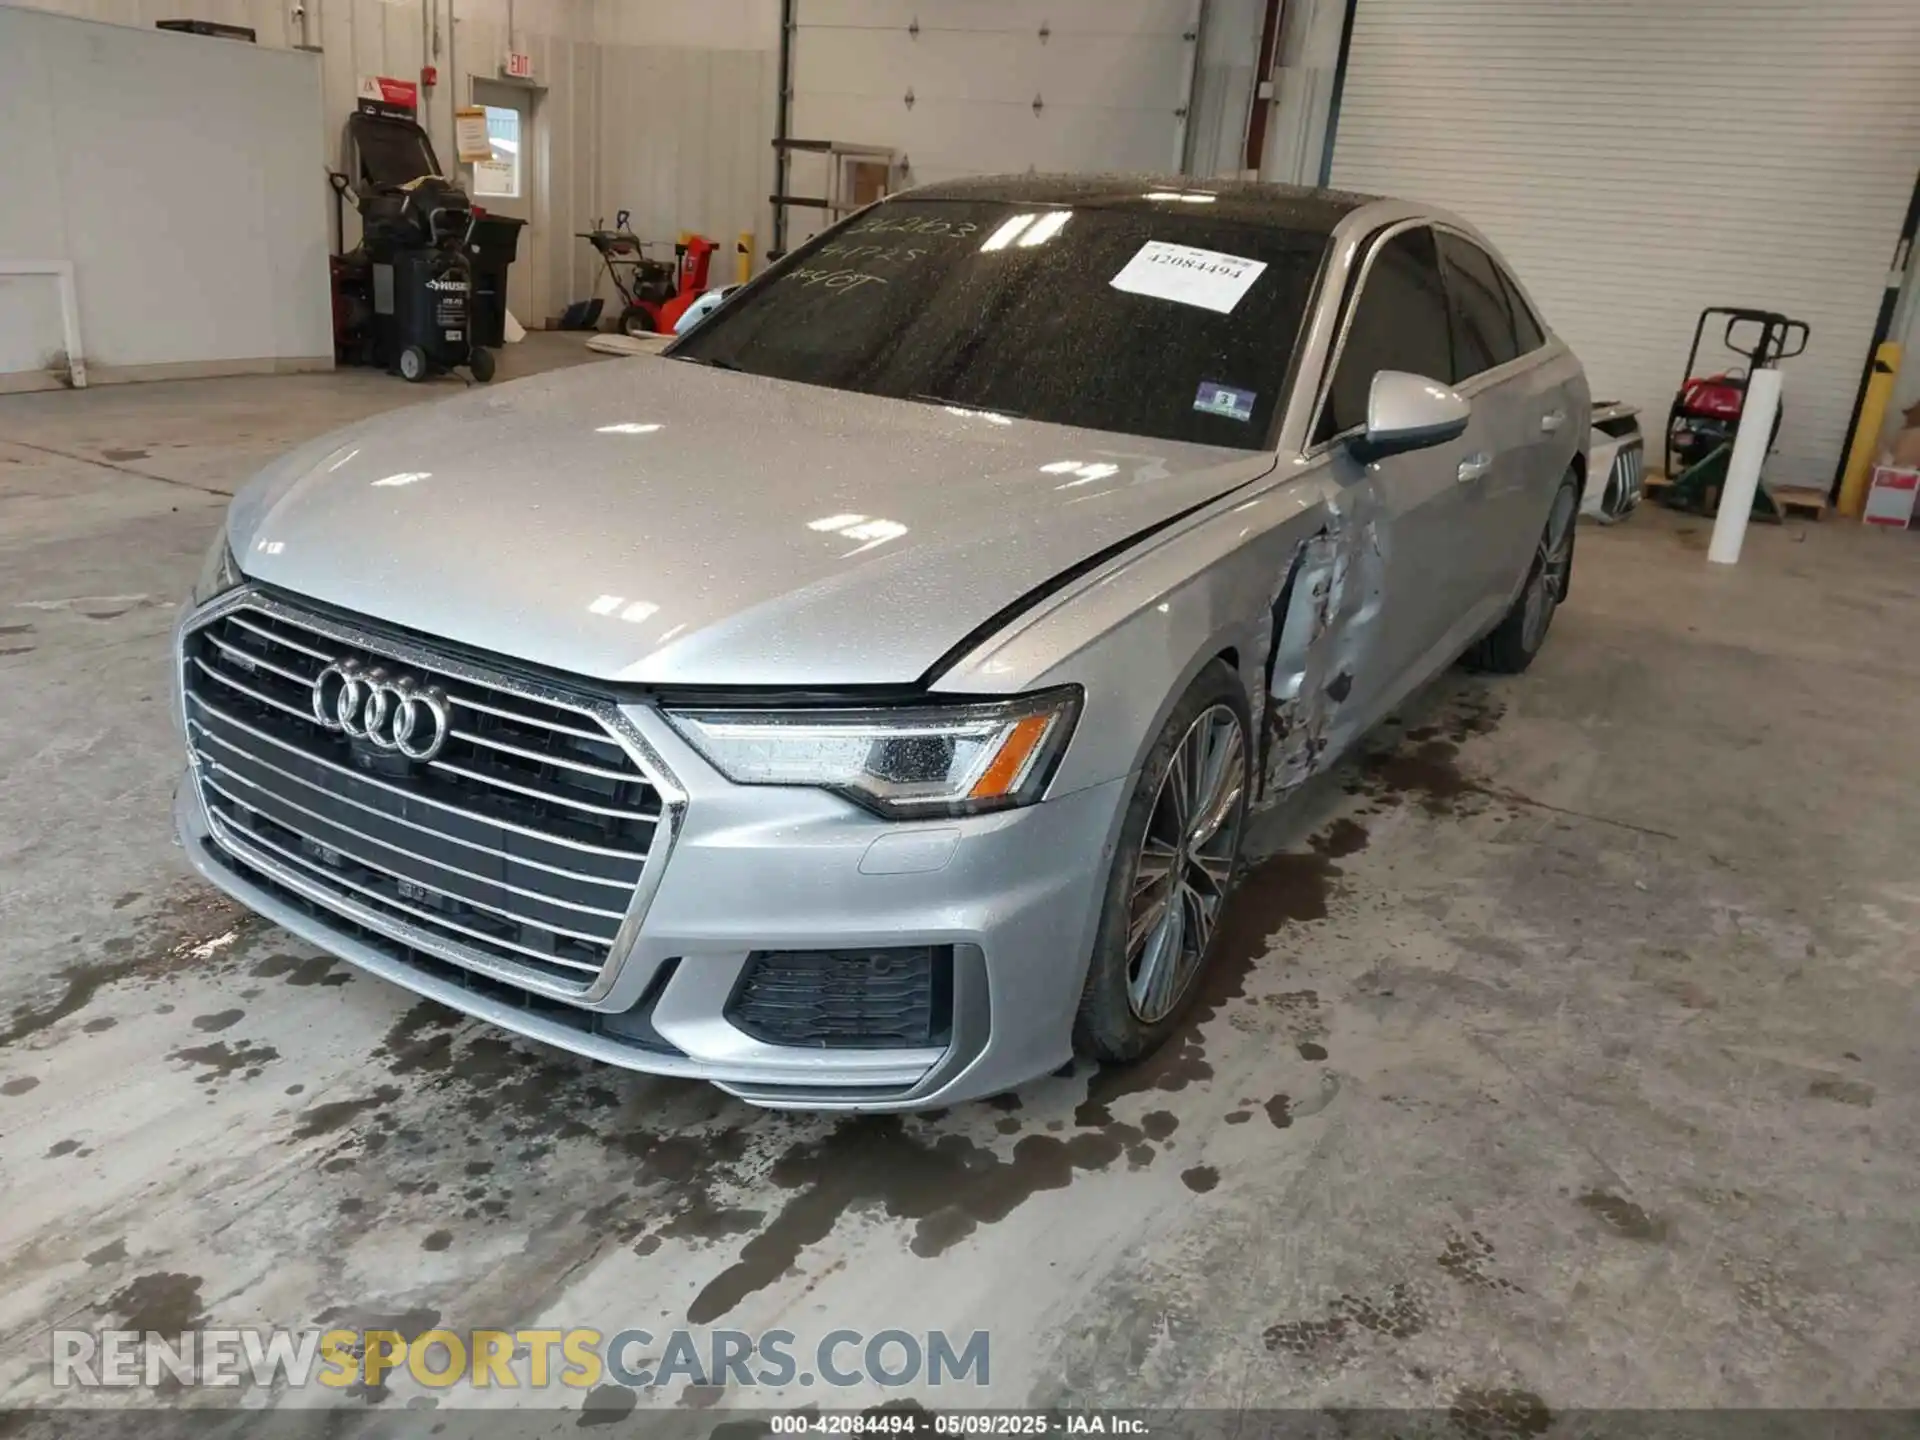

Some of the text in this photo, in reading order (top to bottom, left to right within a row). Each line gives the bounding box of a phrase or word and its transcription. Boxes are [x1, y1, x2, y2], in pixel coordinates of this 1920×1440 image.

[511, 54, 529, 75] EXIT
[1147, 253, 1242, 279] 42084494
[1219, 393, 1229, 405] 3
